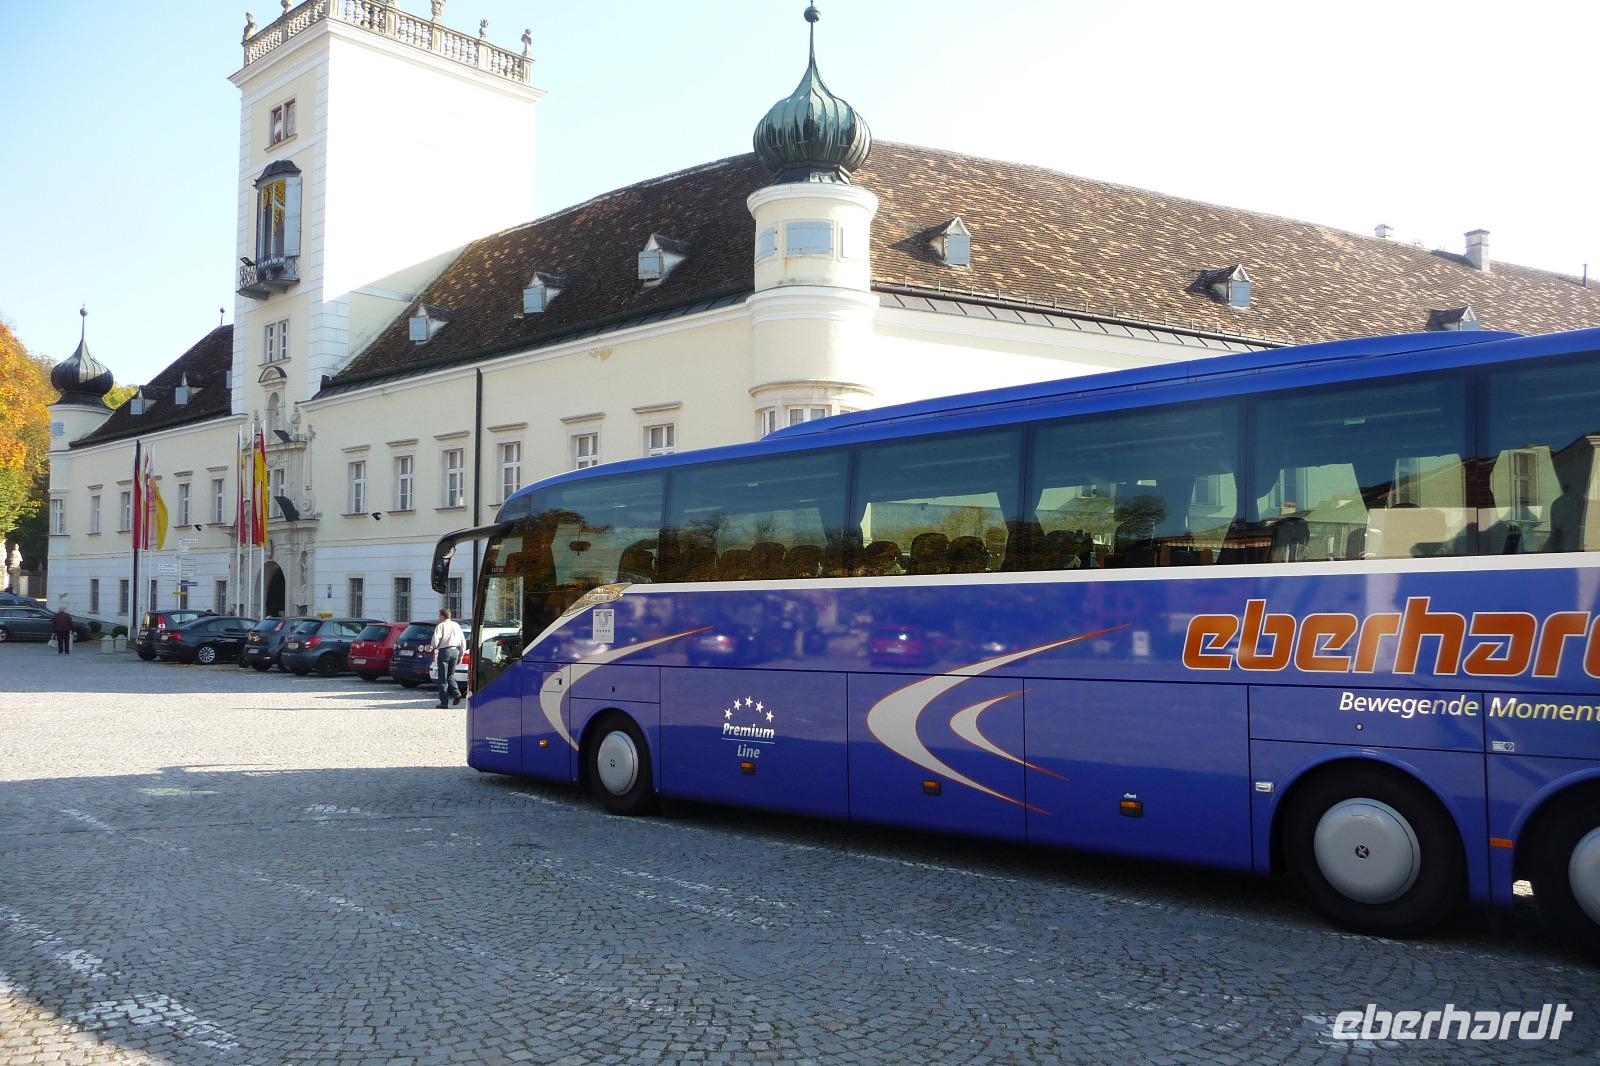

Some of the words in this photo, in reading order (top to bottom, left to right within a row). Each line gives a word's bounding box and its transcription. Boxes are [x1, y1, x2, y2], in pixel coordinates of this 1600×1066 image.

[1182, 596, 1600, 678] eberhar
[1339, 691, 1479, 719] Bewegende
[722, 722, 775, 739] Premium
[737, 743, 761, 759] Line
